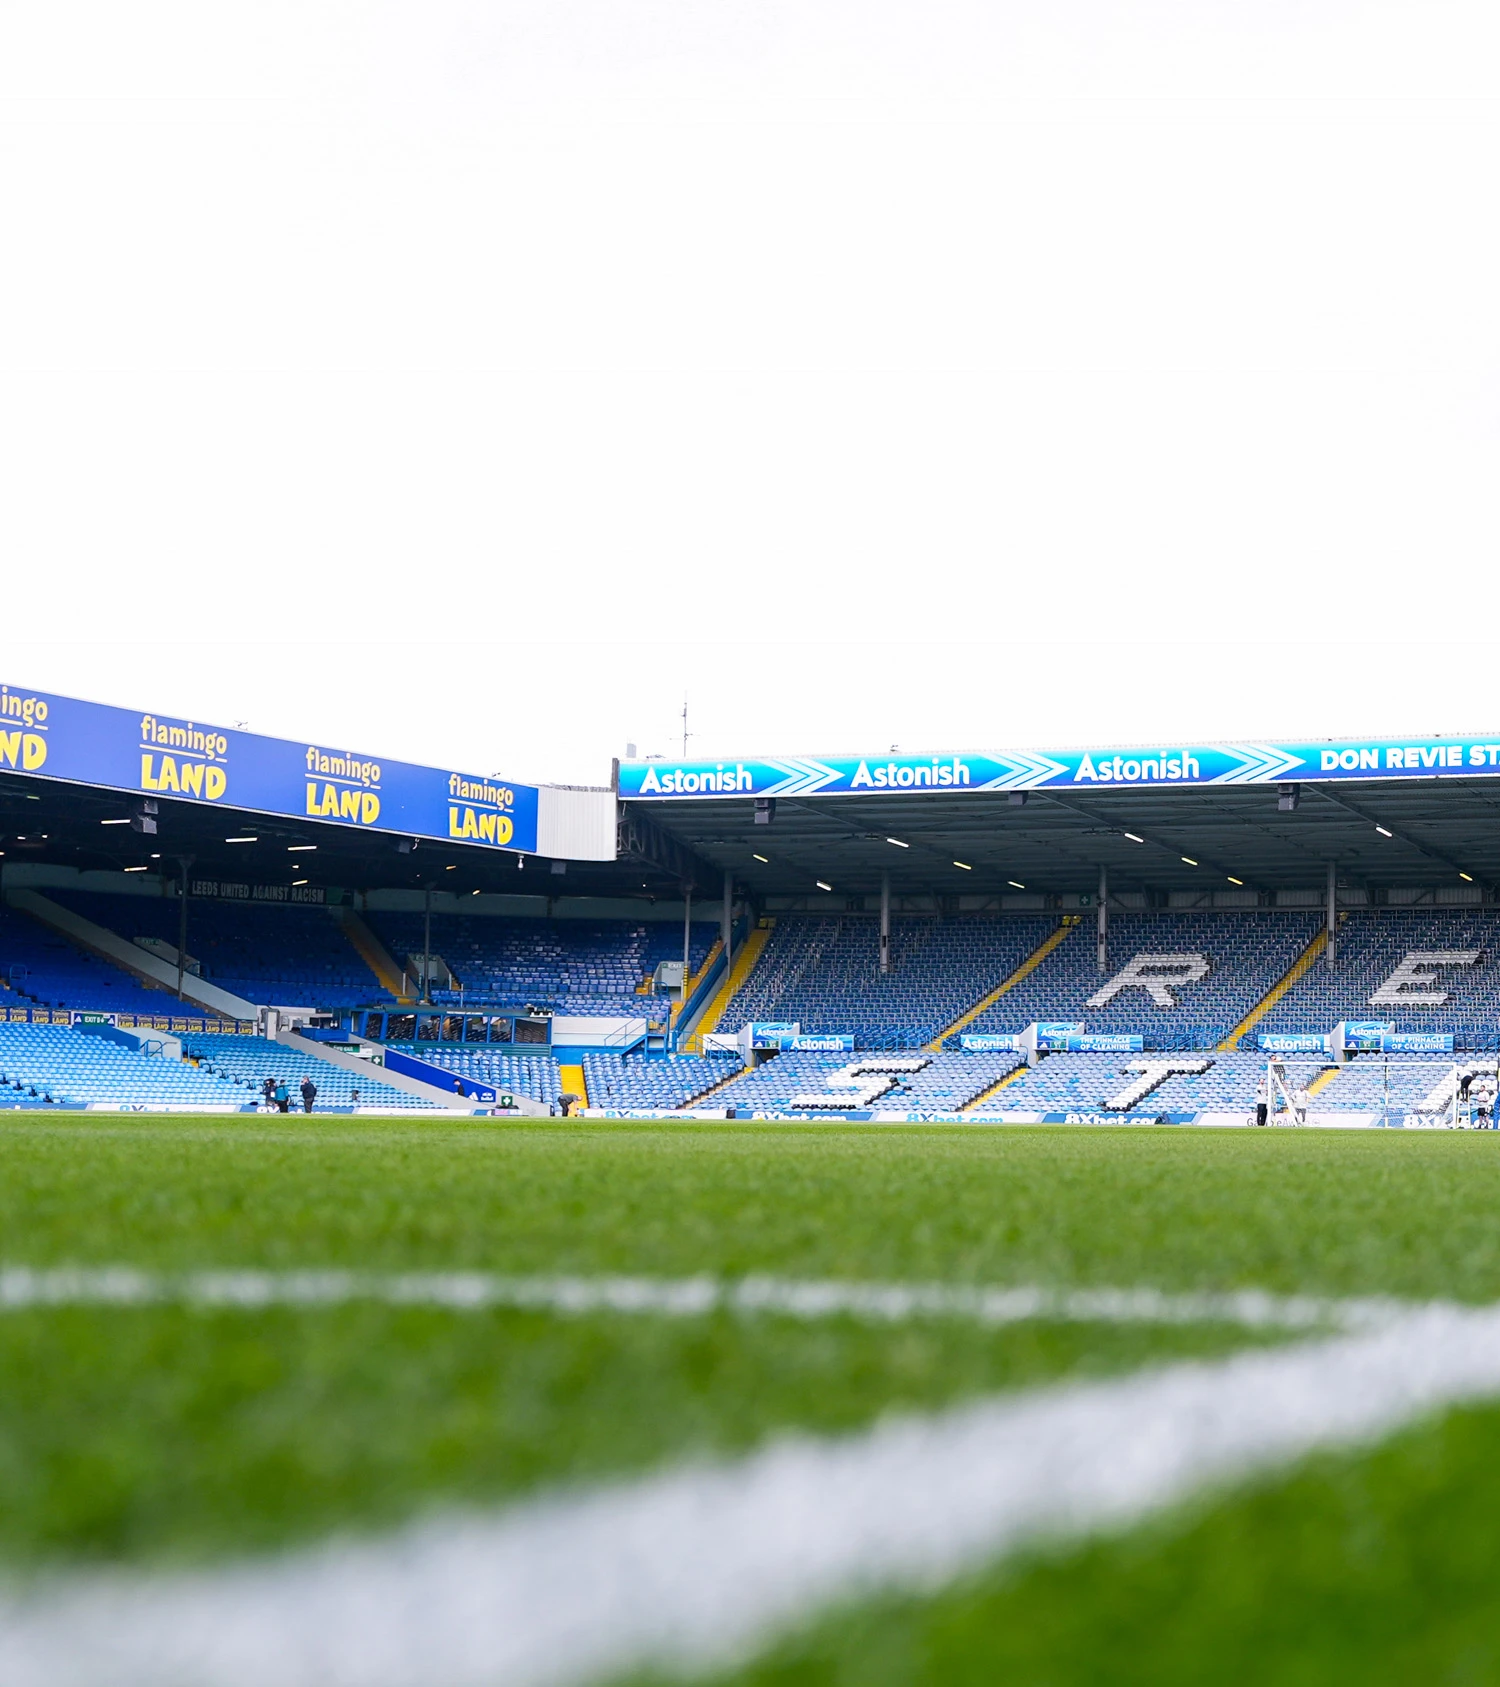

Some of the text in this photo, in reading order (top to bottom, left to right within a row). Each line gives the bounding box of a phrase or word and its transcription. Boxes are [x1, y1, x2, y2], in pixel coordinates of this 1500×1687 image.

[140, 715, 228, 760] flamingo
[305, 746, 381, 787] flamingo
[850, 757, 970, 788] Astonish
[1074, 750, 1200, 783] Astonish
[1320, 748, 1380, 772] DON
[1386, 745, 1463, 770] REVIE
[141, 754, 227, 800] LAND
[448, 774, 514, 811] flamingo
[639, 763, 752, 794] Astonish
[306, 782, 381, 825] LAND
[449, 806, 514, 845] LAND
[192, 880, 324, 903] LEEDS UNITED AGAINST RACISM
[791, 1036, 844, 1050] Astonish
[962, 1036, 1012, 1050] Astonish
[1263, 1037, 1321, 1051] Astonish
